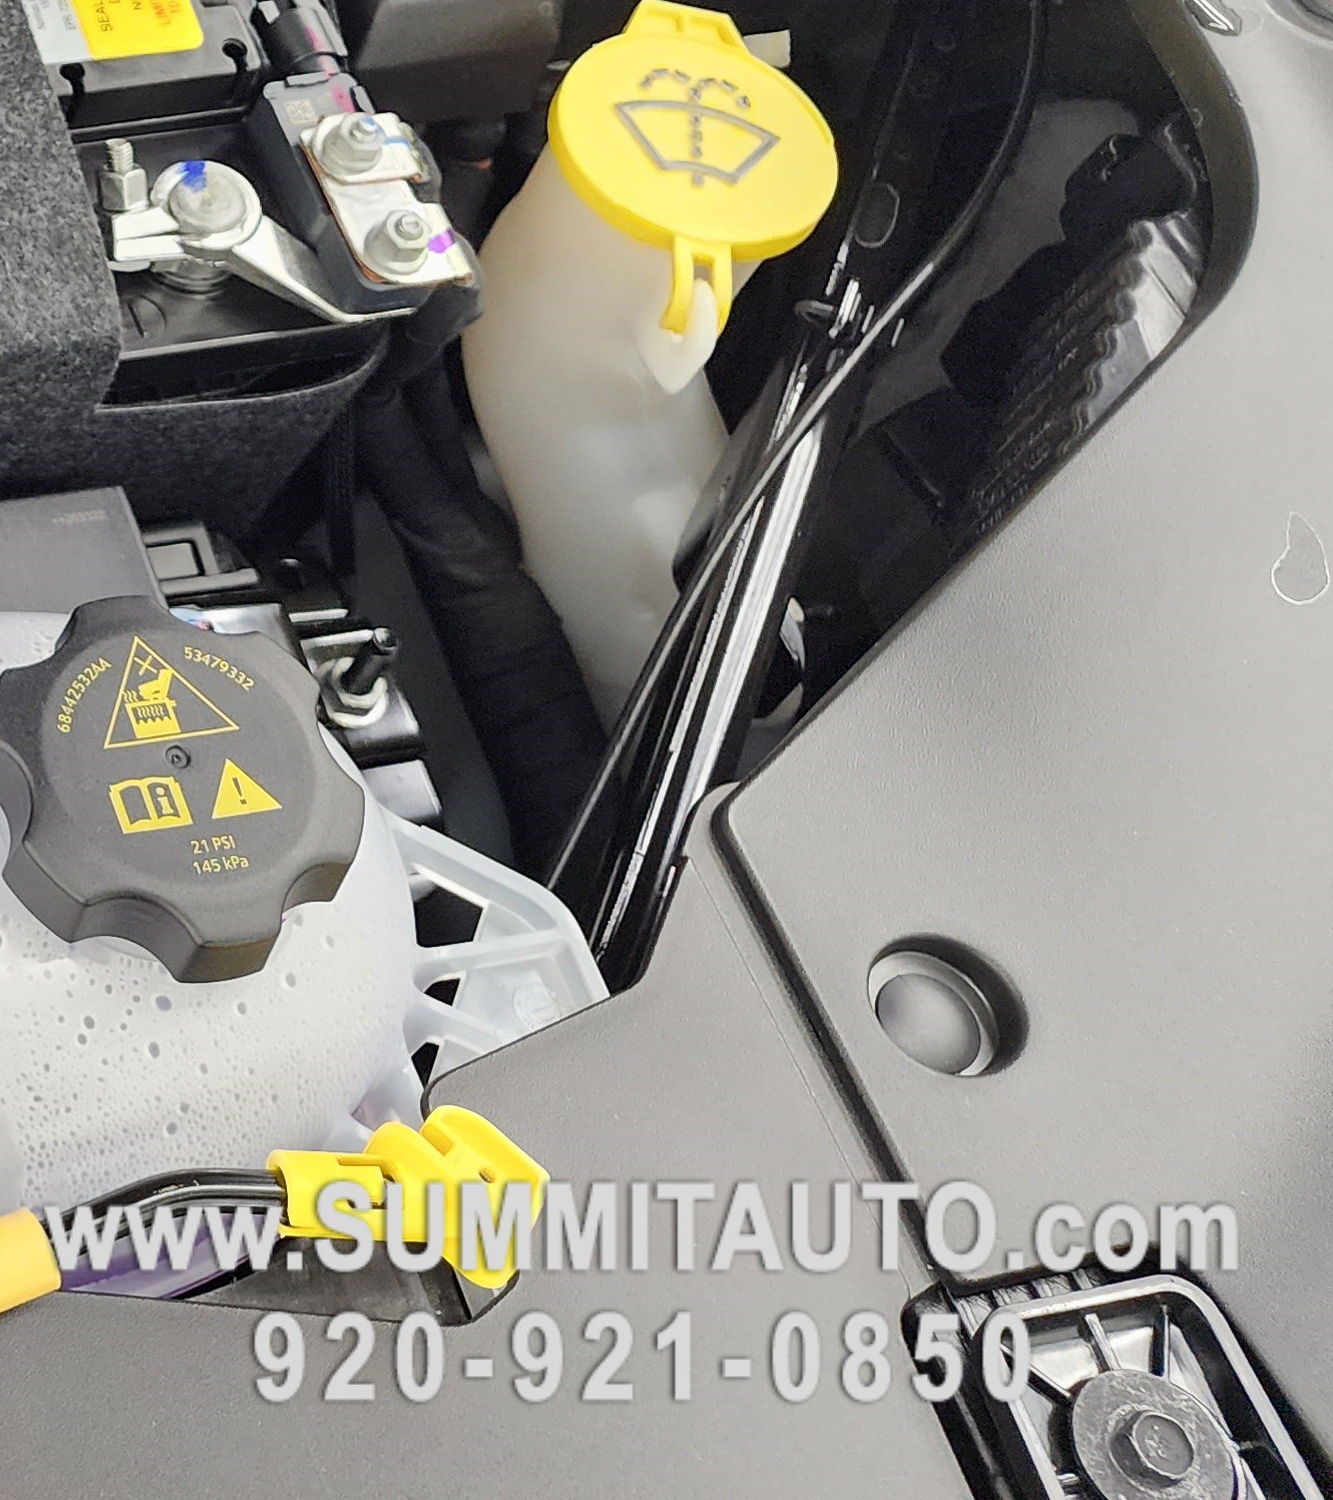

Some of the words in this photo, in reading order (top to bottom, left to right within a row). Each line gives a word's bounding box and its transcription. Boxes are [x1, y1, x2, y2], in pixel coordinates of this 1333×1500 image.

[184, 646, 256, 692] 53479332
[56, 656, 112, 733] 68442532AA
[190, 838, 210, 855] 21
[211, 835, 236, 852] PSI
[193, 858, 221, 875] 145
[221, 855, 250, 871] kPa
